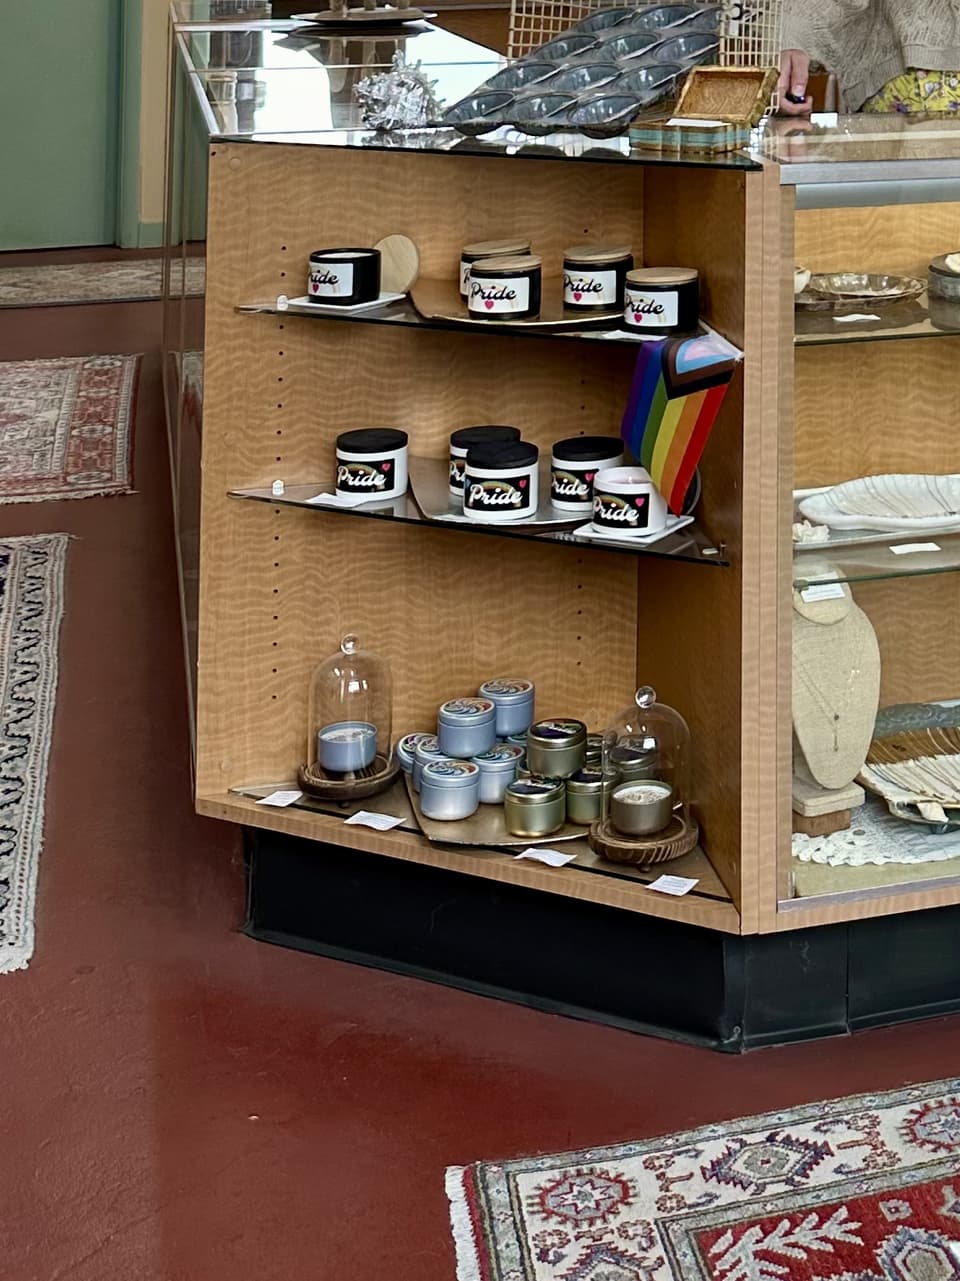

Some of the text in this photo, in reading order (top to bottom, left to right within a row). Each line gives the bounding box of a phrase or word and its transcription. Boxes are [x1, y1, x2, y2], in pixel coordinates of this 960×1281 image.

[471, 282, 517, 300] Pride
[338, 465, 387, 487] Pride
[552, 474, 590, 495] ride
[469, 484, 523, 505] Pride
